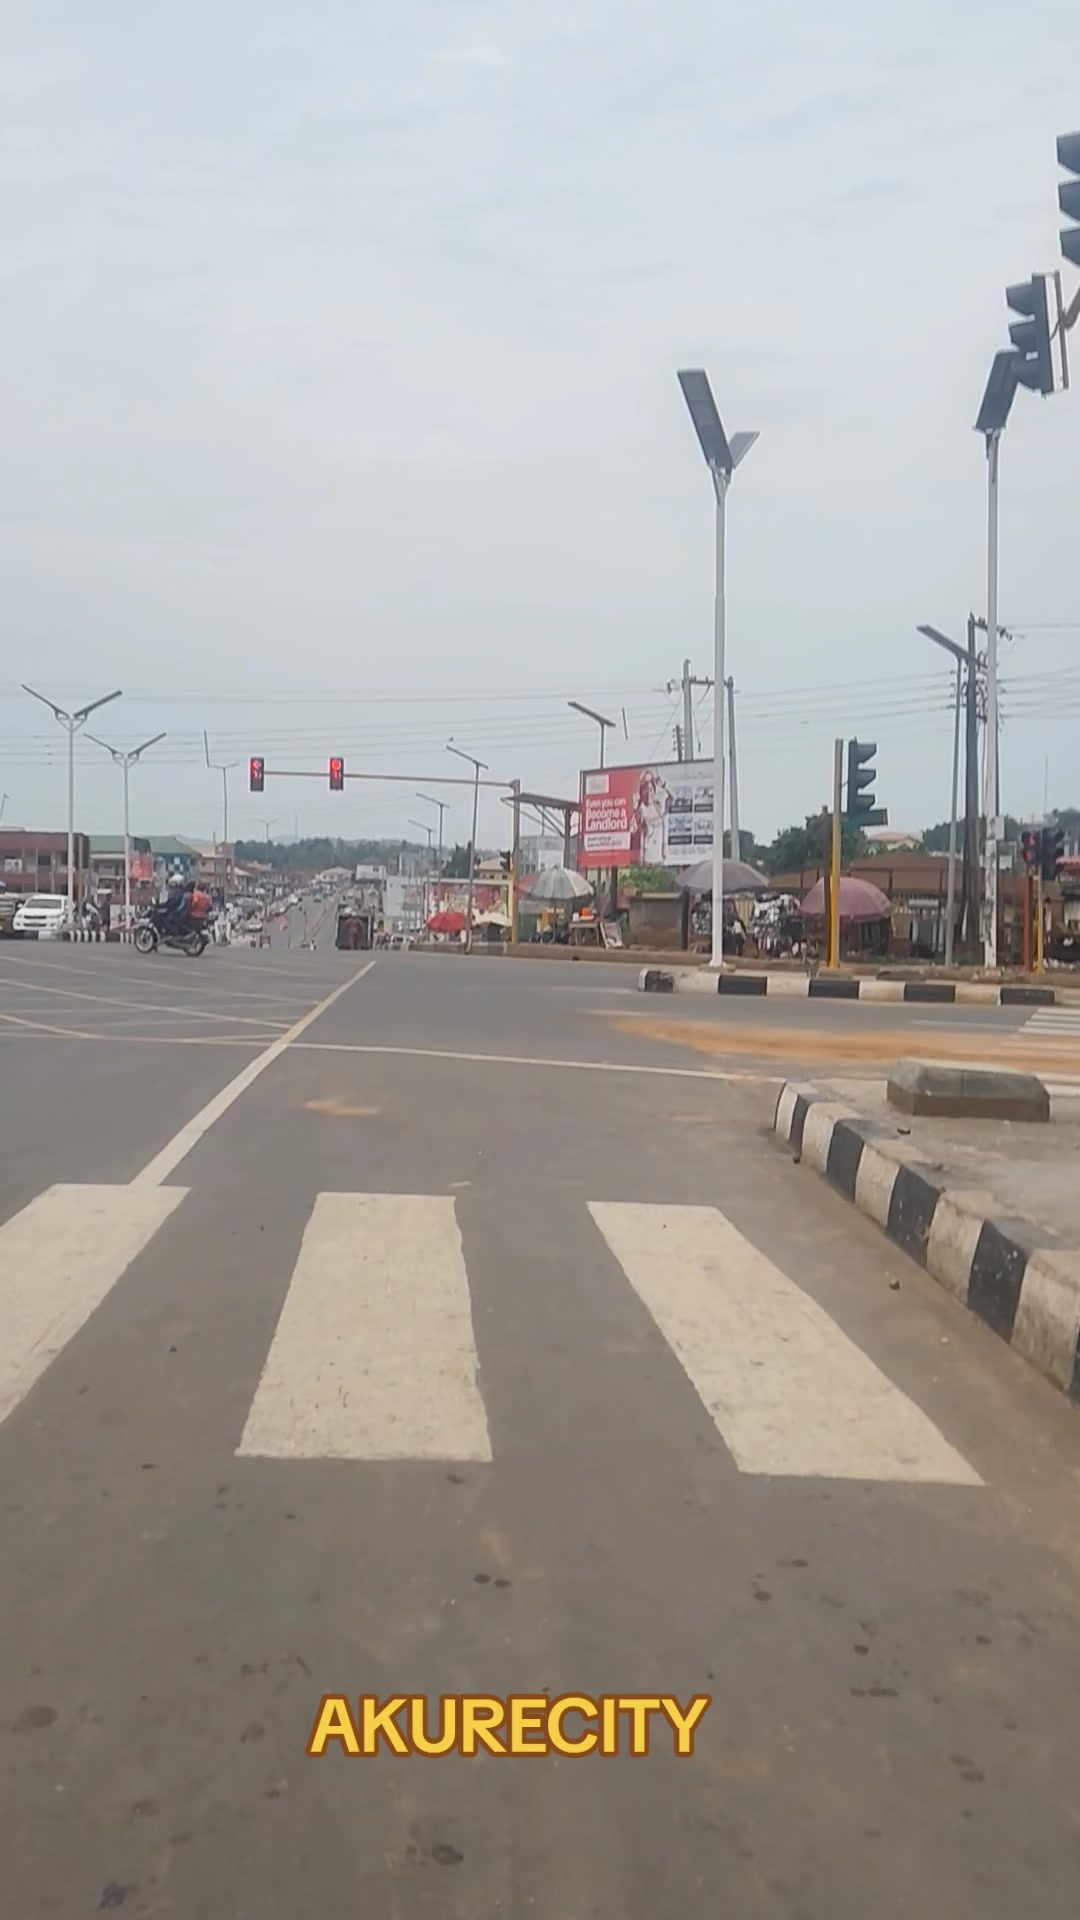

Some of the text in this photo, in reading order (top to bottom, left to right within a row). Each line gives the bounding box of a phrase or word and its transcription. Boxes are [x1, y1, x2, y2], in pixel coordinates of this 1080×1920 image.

[601, 799, 614, 810] you
[586, 808, 627, 820] Become a
[586, 816, 628, 831] Landlord
